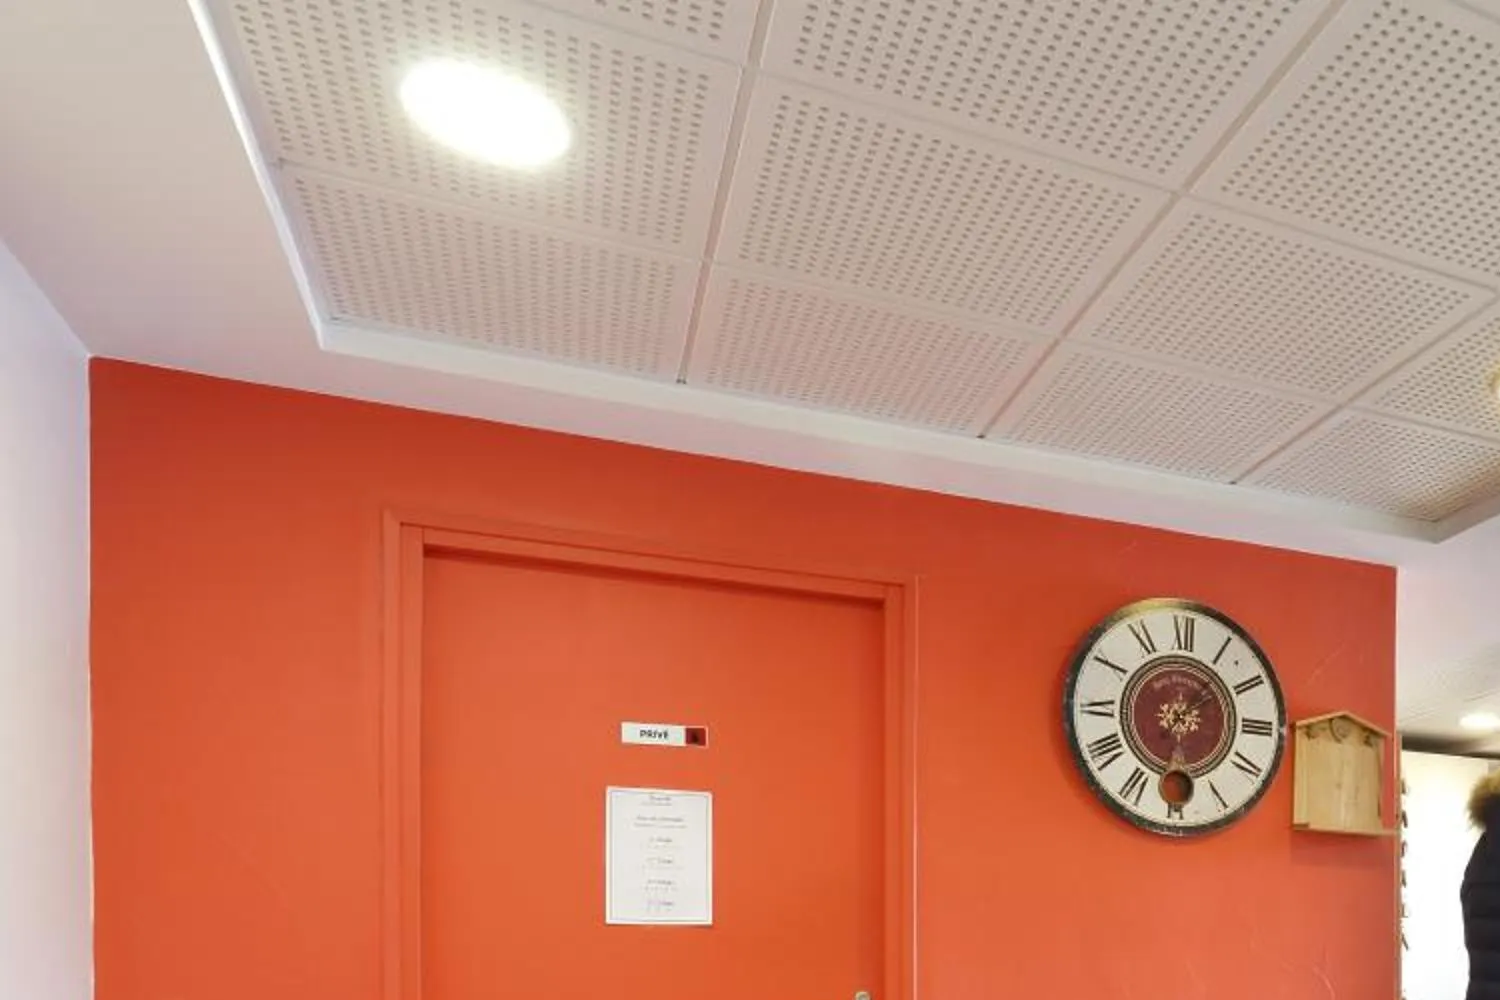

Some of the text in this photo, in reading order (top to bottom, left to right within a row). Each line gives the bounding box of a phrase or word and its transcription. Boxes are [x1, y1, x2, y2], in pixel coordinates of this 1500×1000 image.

[1172, 615, 1195, 652] XII
[1233, 674, 1264, 695] II
[1242, 717, 1273, 738] III
